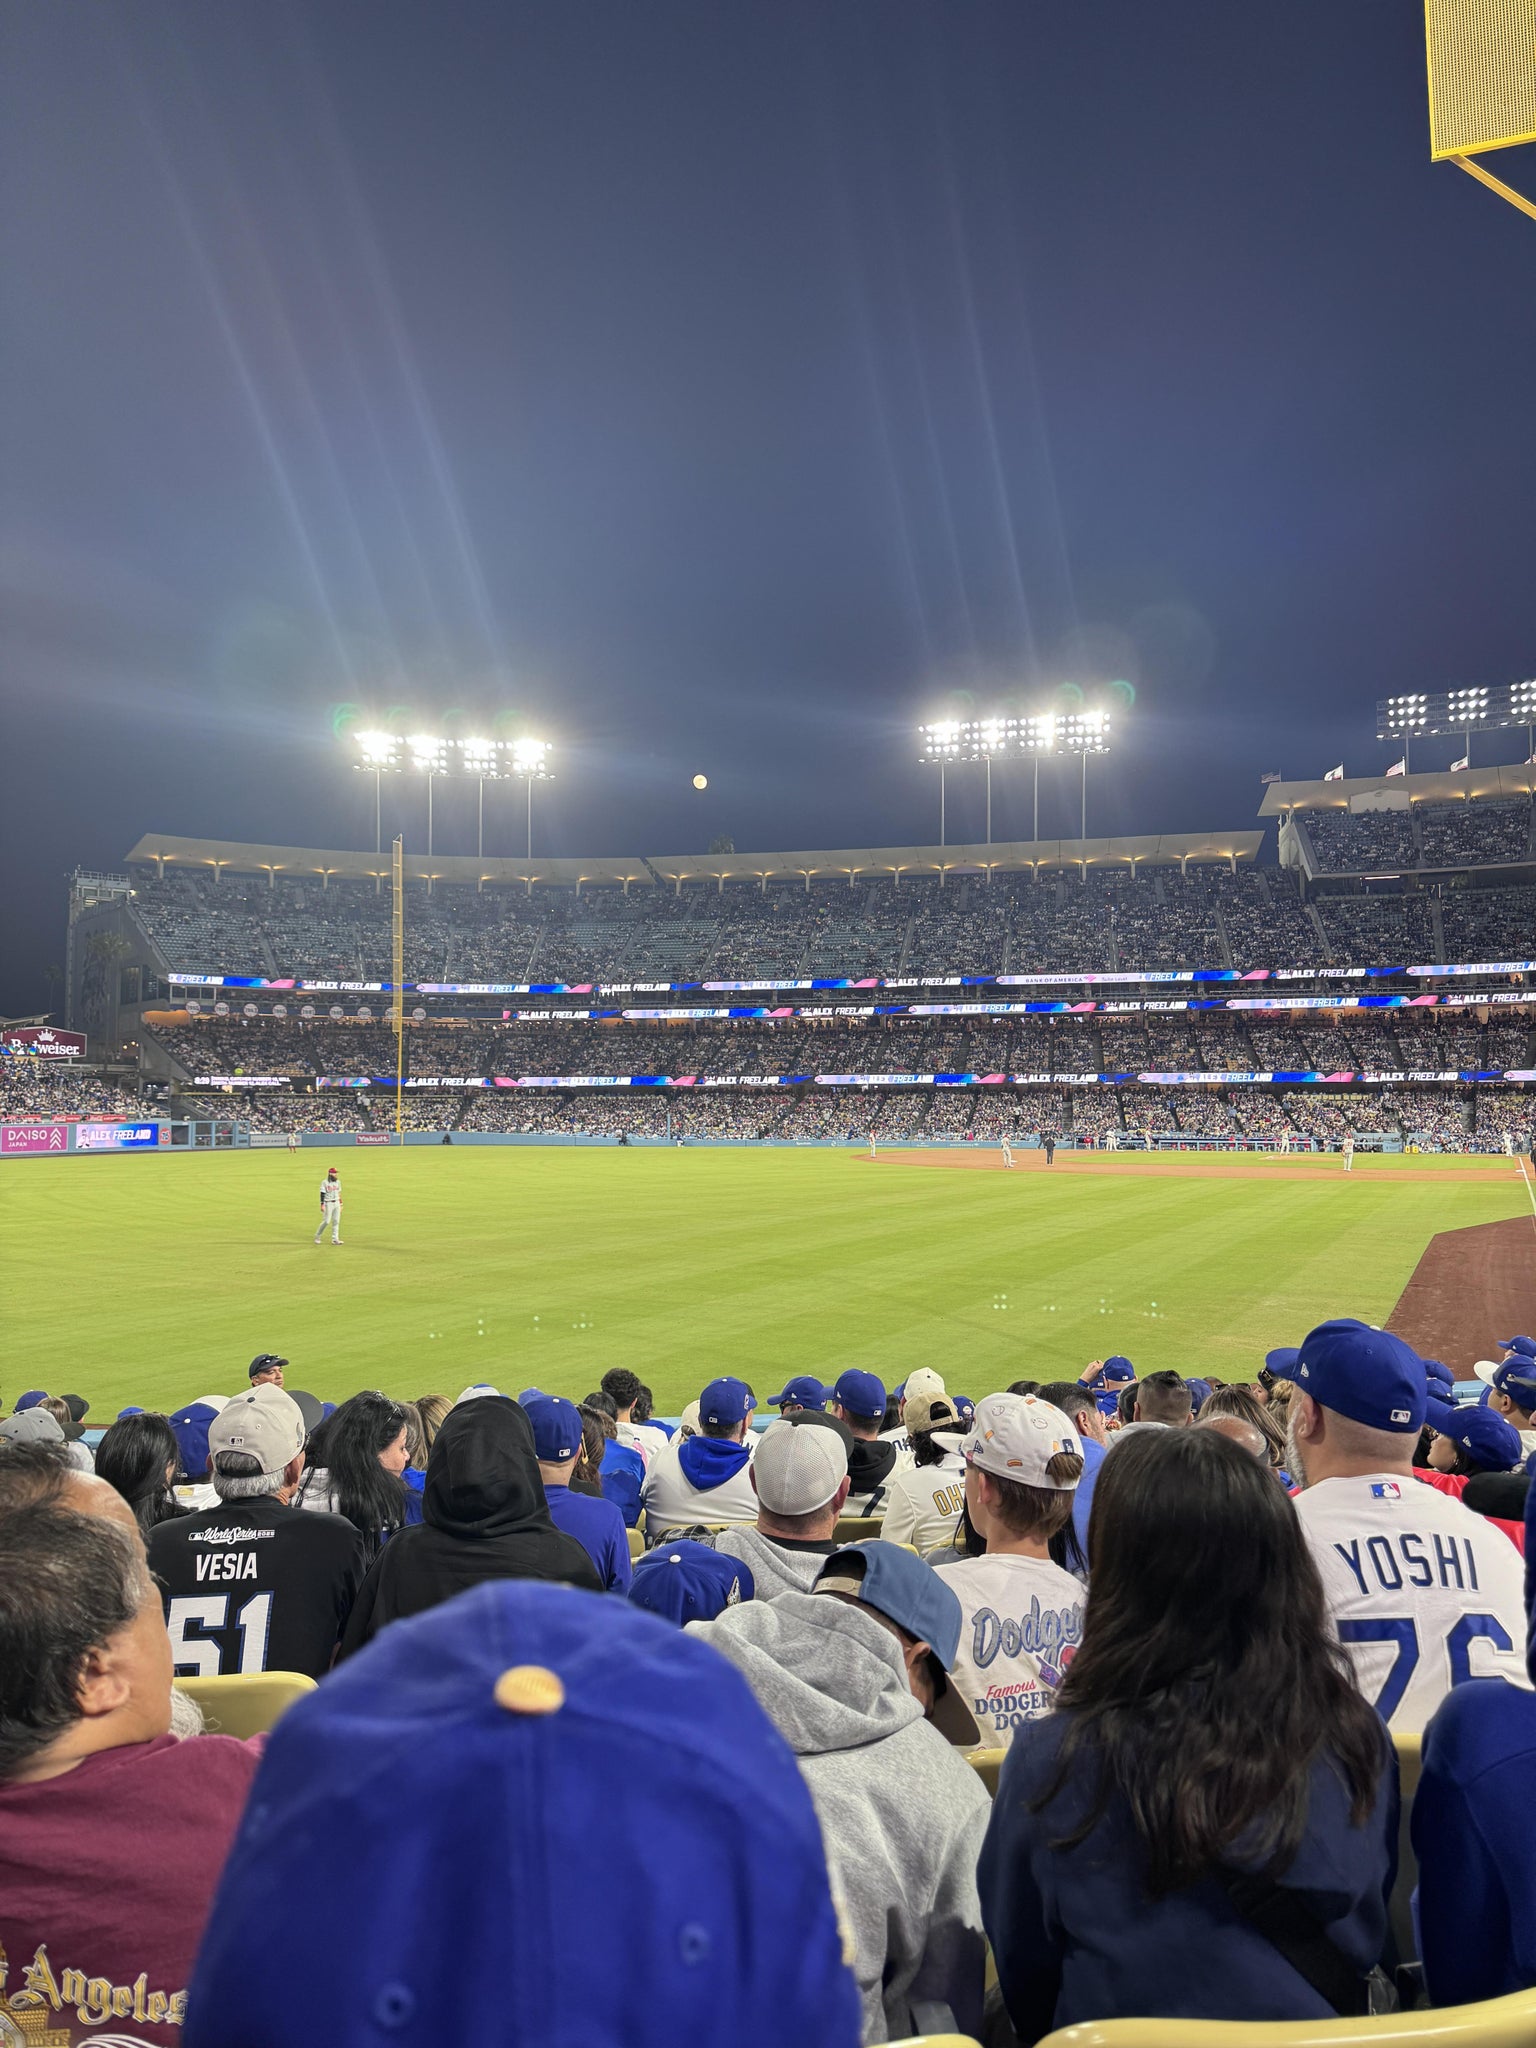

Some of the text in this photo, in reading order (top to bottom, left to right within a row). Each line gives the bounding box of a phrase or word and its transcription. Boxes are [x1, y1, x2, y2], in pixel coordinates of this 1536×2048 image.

[1499, 962, 1536, 971] FREELA
[1292, 968, 1366, 978] ALEX FREELAND
[1464, 995, 1488, 1003] ALEX
[1118, 1001, 1188, 1011] ALEX FREELAND
[1028, 1074, 1098, 1083] ALEX FREELAND
[1199, 1073, 1273, 1082] ALEX FREELAND
[1379, 1072, 1405, 1081] ALEX
[1408, 1072, 1458, 1081] FREELAND
[8, 1130, 47, 1141] DAISO
[90, 1129, 152, 1140] ALEX FREELAND
[358, 1135, 389, 1144] Yakult
[196, 1552, 258, 1581] VESIA
[1332, 1533, 1480, 1596] YOSHI
[167, 1591, 275, 1676] 51
[985, 1679, 1037, 1700] Famous
[9, 1943, 189, 2026] Angeles
